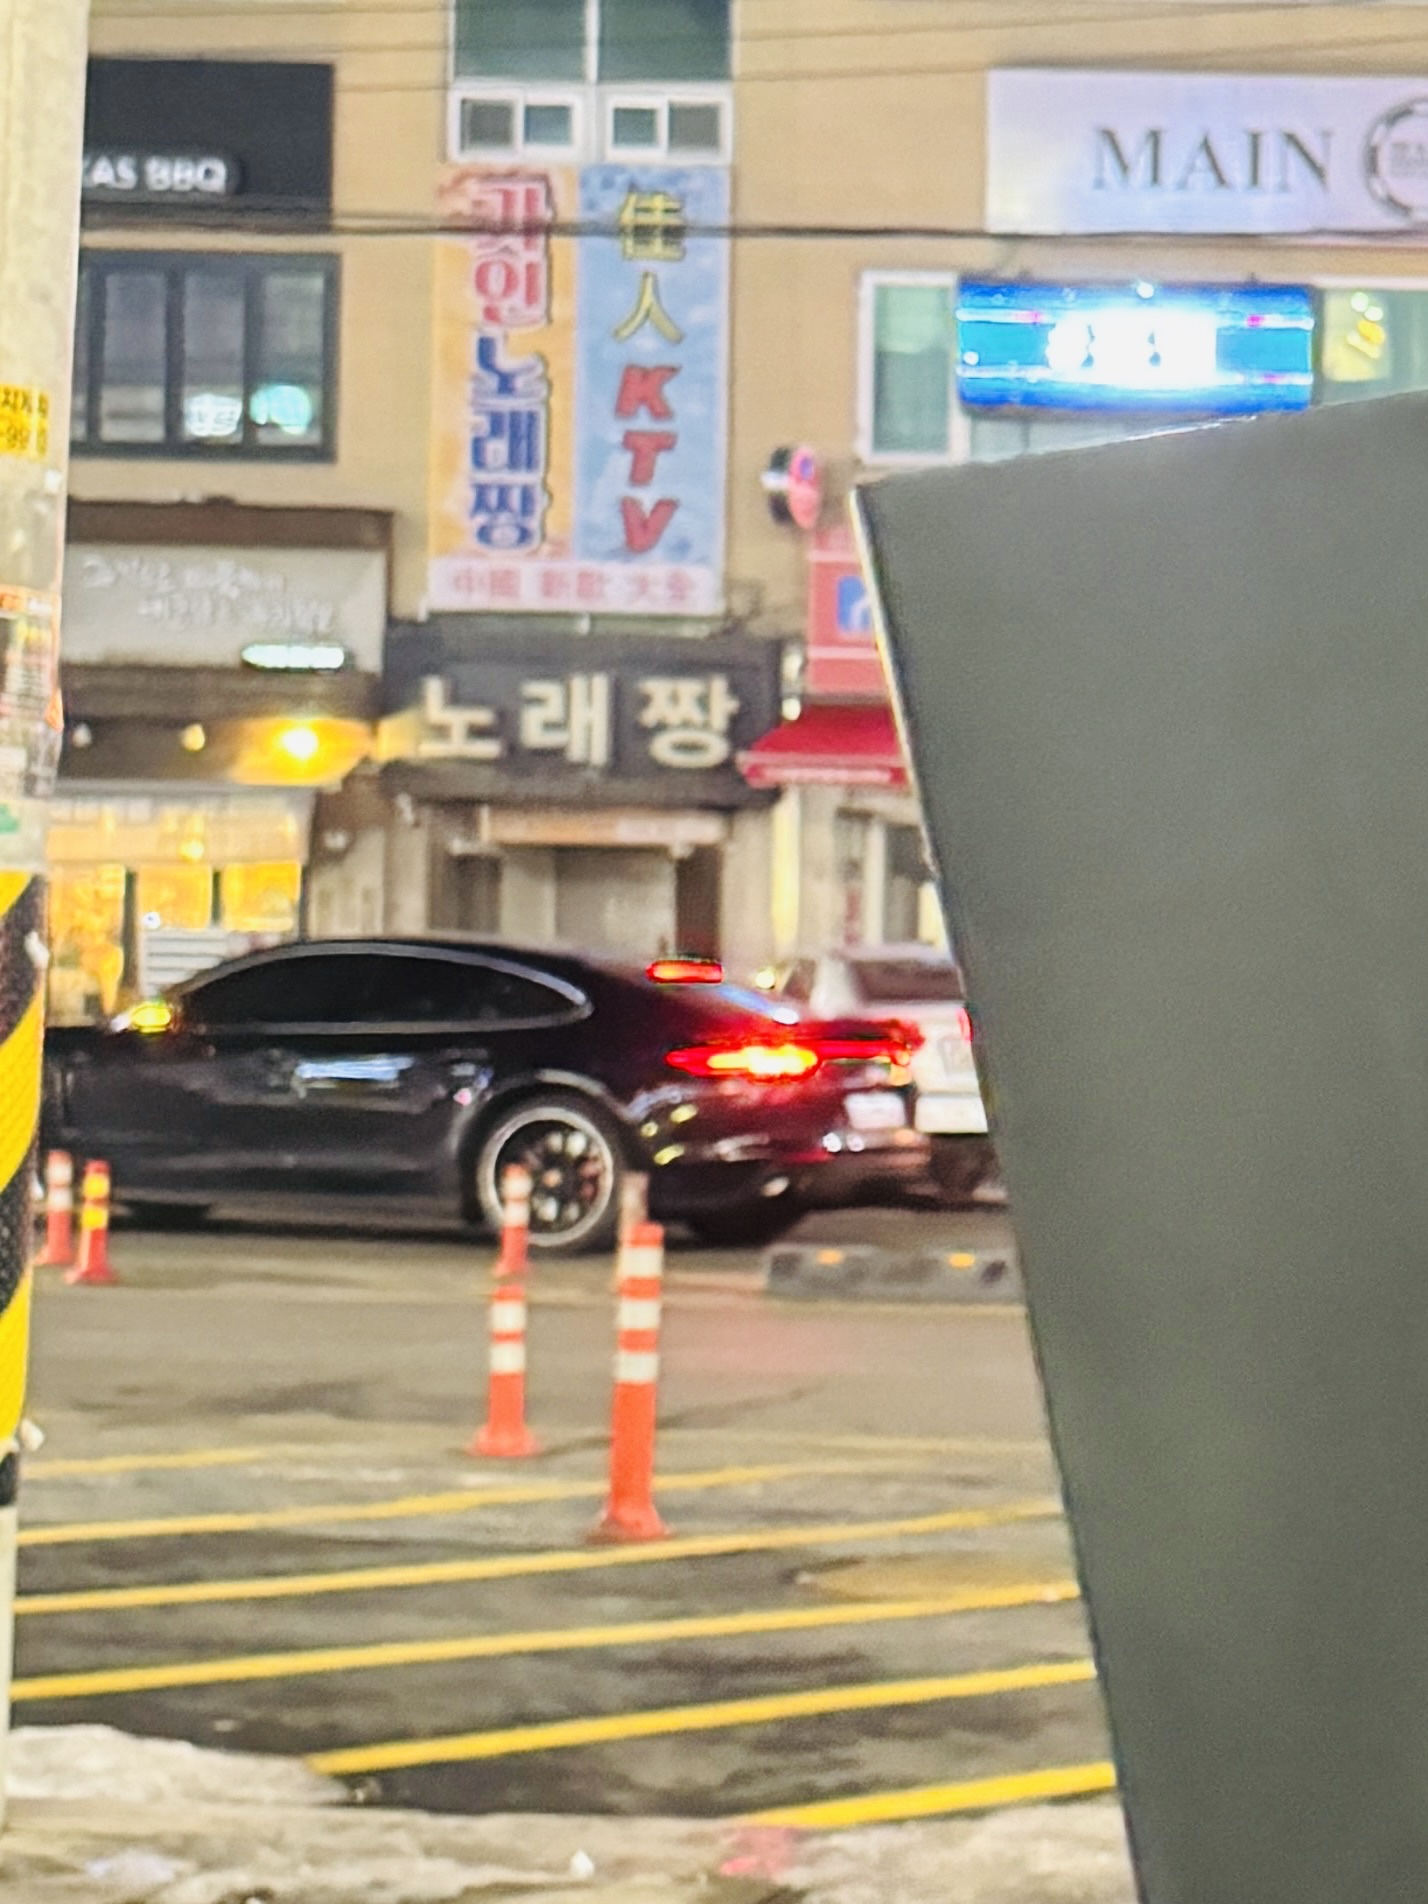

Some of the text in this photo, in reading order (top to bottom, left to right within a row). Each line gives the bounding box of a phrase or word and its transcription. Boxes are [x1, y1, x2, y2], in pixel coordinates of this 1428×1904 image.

[144, 155, 227, 193] BBQ
[1091, 128, 1335, 192] MAIN
[422, 668, 740, 771] 노래짱
